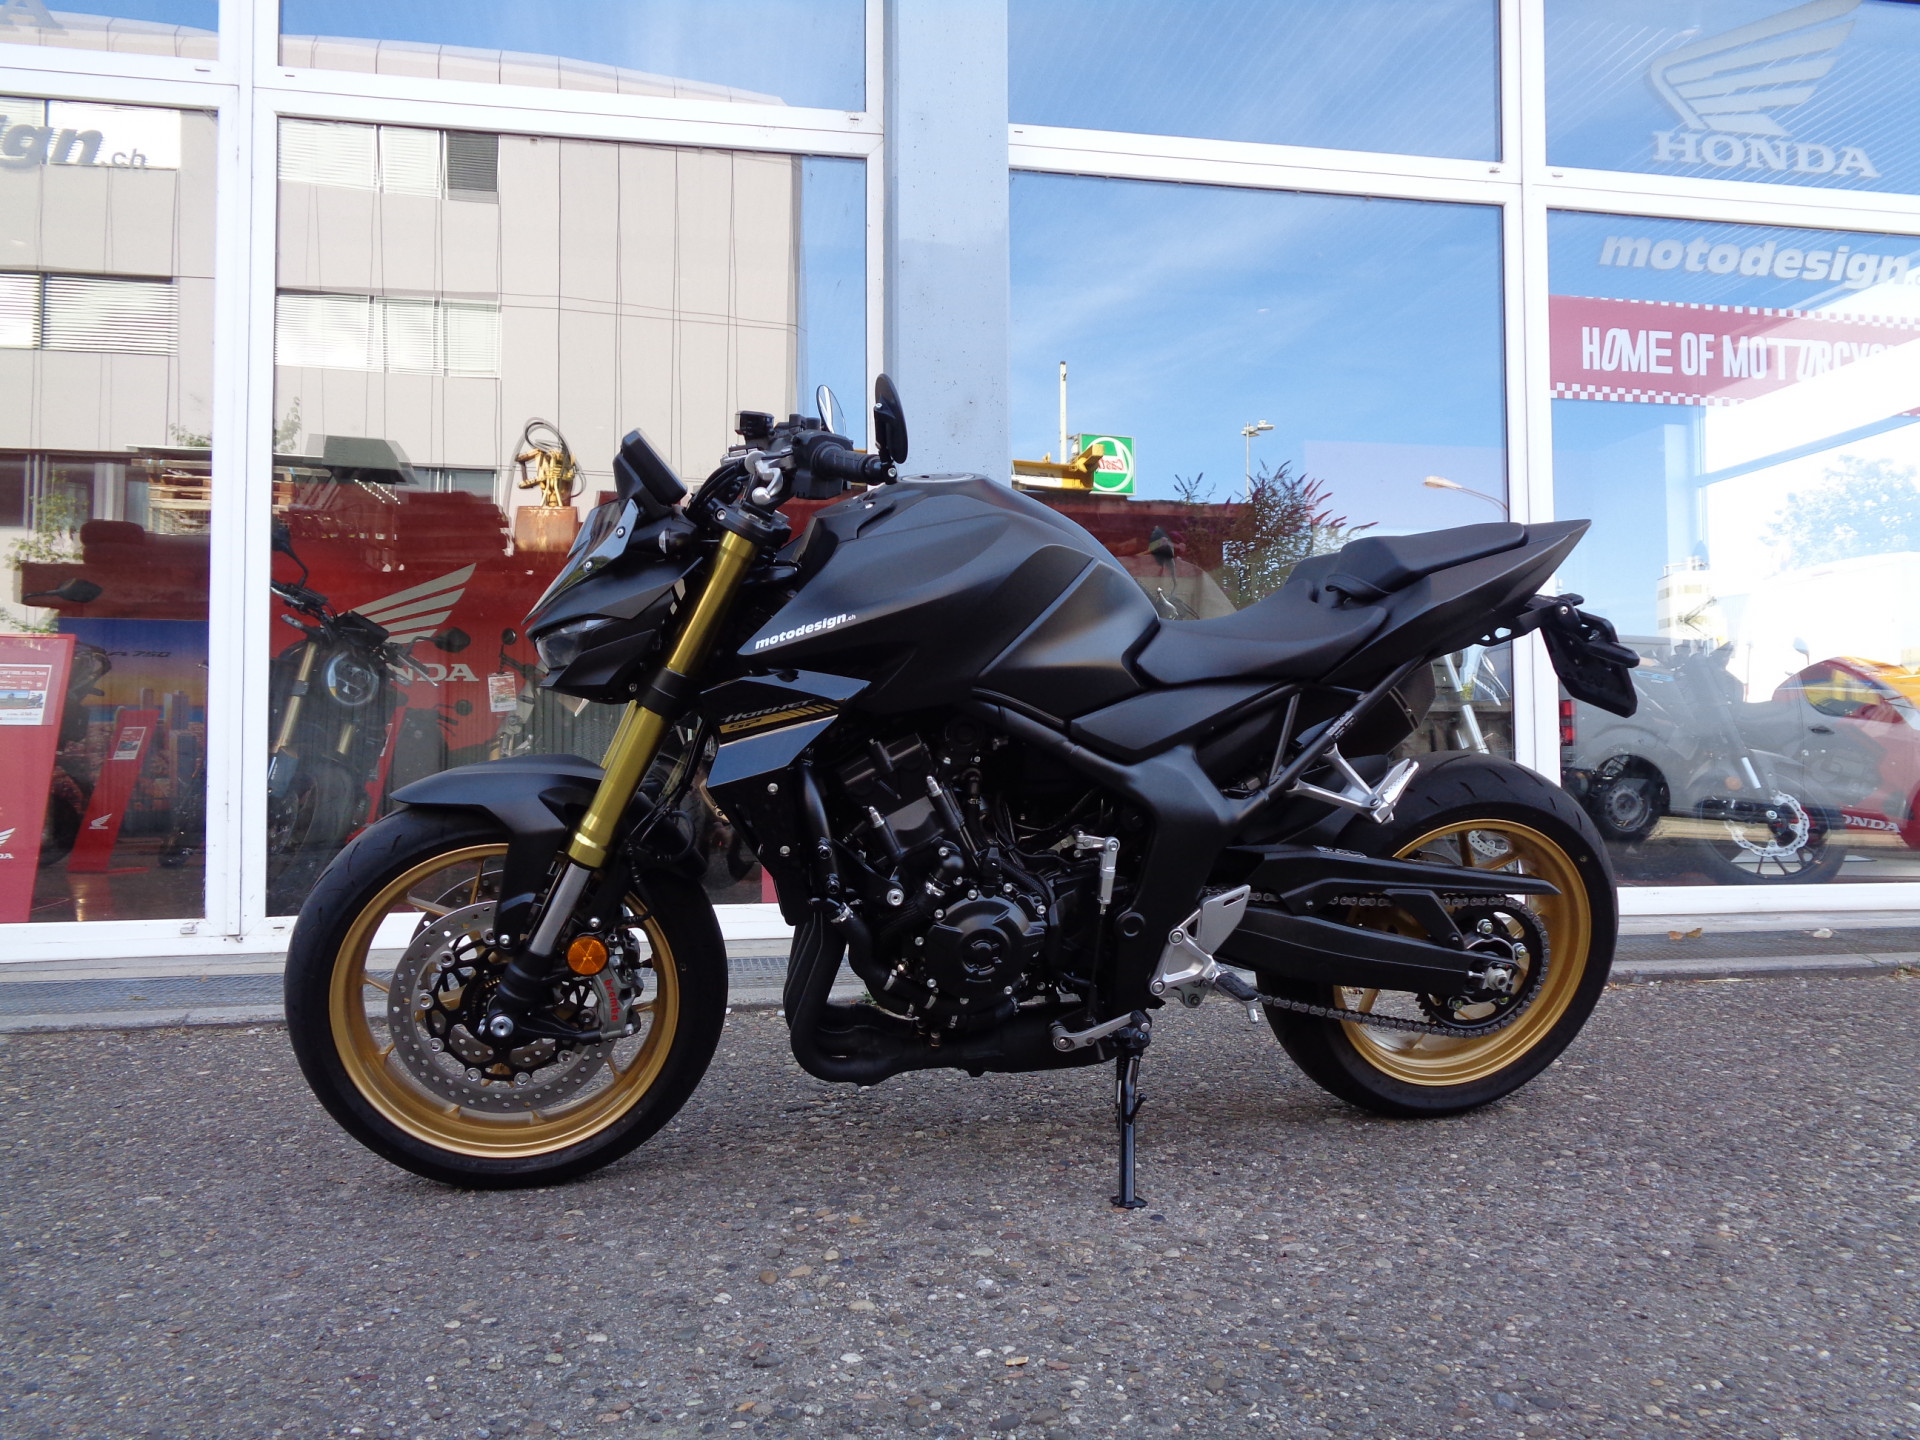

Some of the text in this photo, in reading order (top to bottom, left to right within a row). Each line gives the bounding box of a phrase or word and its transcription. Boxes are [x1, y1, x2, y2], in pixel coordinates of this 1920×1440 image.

[1652, 131, 1882, 178] HONDA
[1681, 332, 1715, 376] OF
[755, 613, 857, 650] motodesign.ch
[603, 978, 620, 1022] brembo
